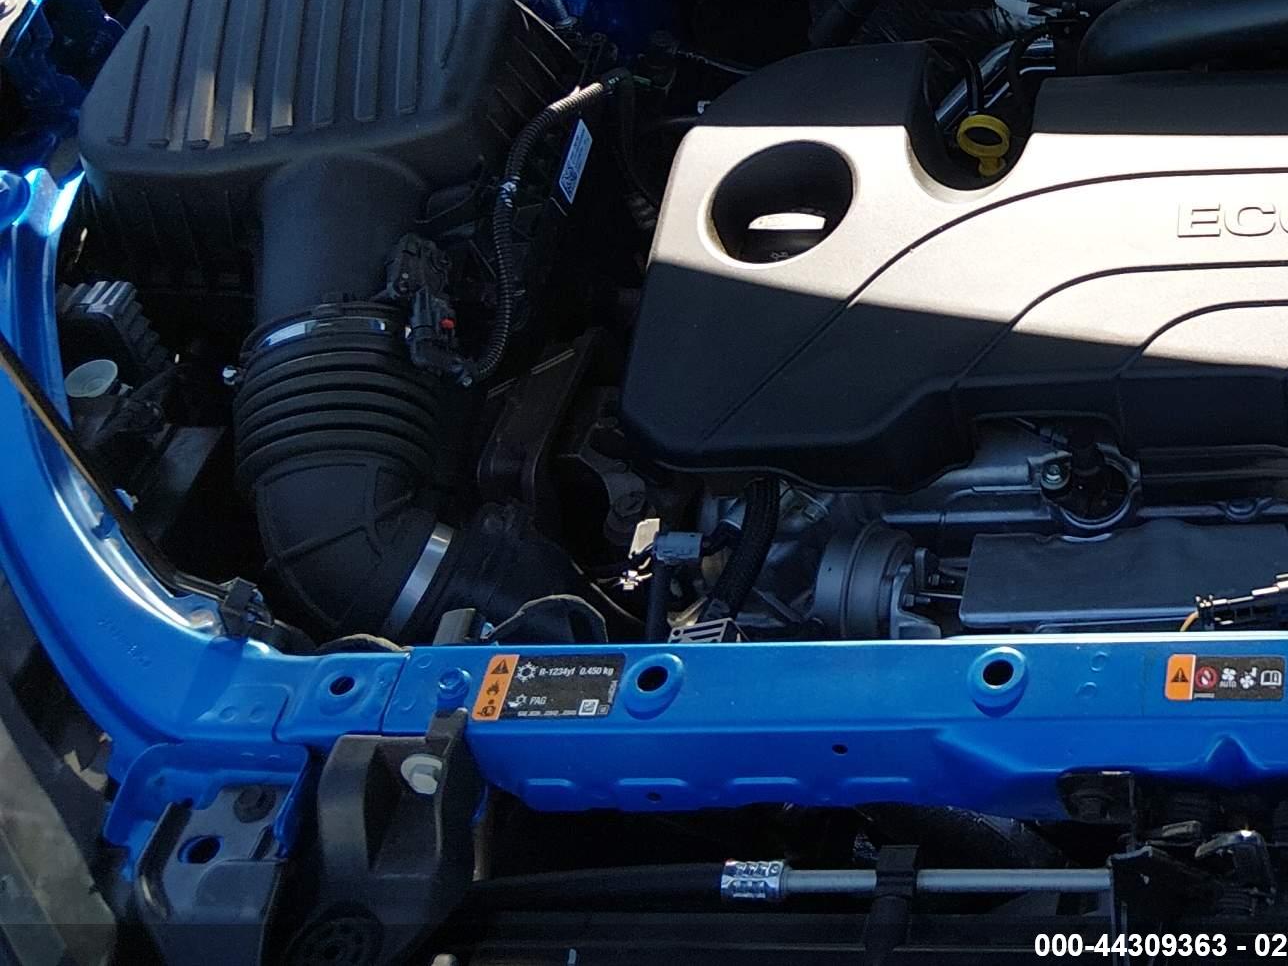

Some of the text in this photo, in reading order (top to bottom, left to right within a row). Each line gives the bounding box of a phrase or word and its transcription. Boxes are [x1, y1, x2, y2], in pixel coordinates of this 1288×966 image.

[538, 666, 614, 677] R-1234yf 0.450 kg
[529, 696, 548, 705] PAG
